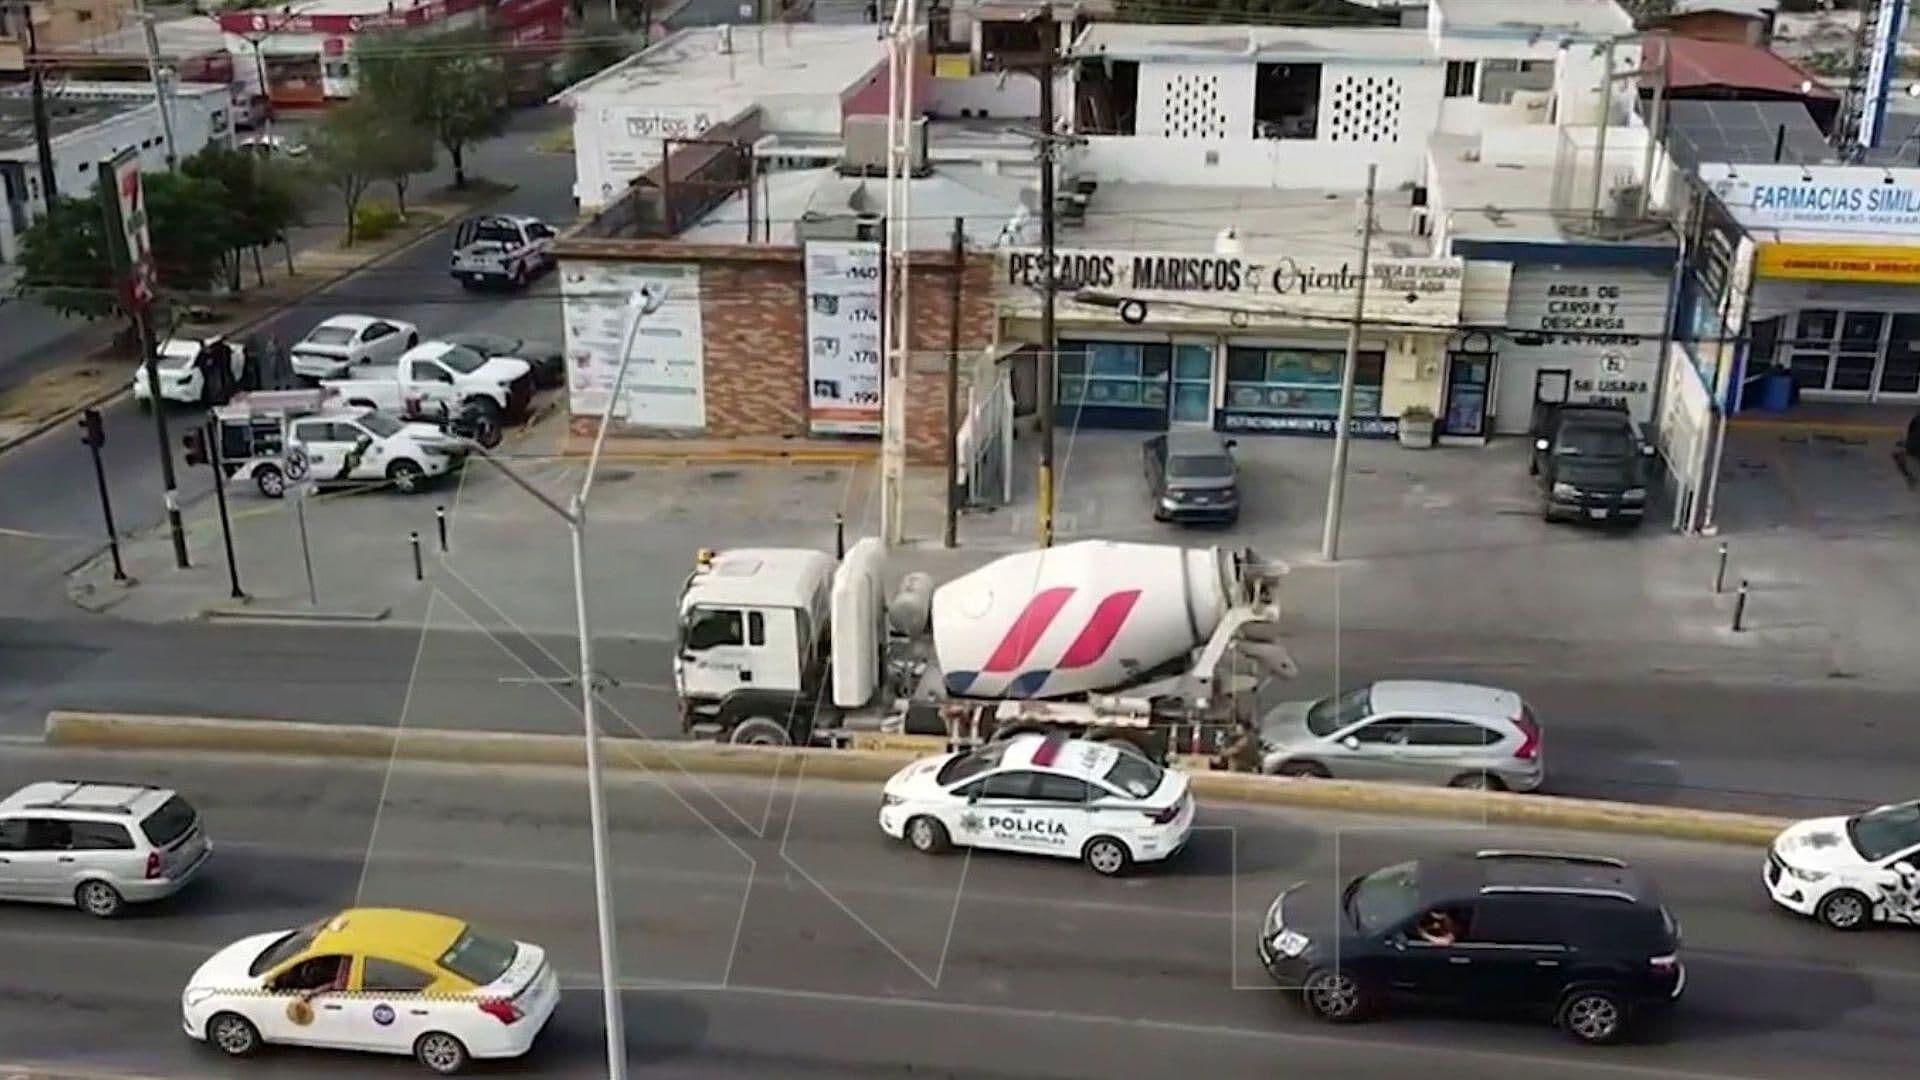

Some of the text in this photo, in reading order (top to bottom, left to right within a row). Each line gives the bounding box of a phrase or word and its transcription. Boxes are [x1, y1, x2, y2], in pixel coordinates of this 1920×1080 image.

[1753, 186, 1862, 211] FARMACIAS
[1132, 256, 1240, 291] MARISCOS
[1597, 286, 1620, 298] DE
[1542, 316, 1625, 329] DESCARGA
